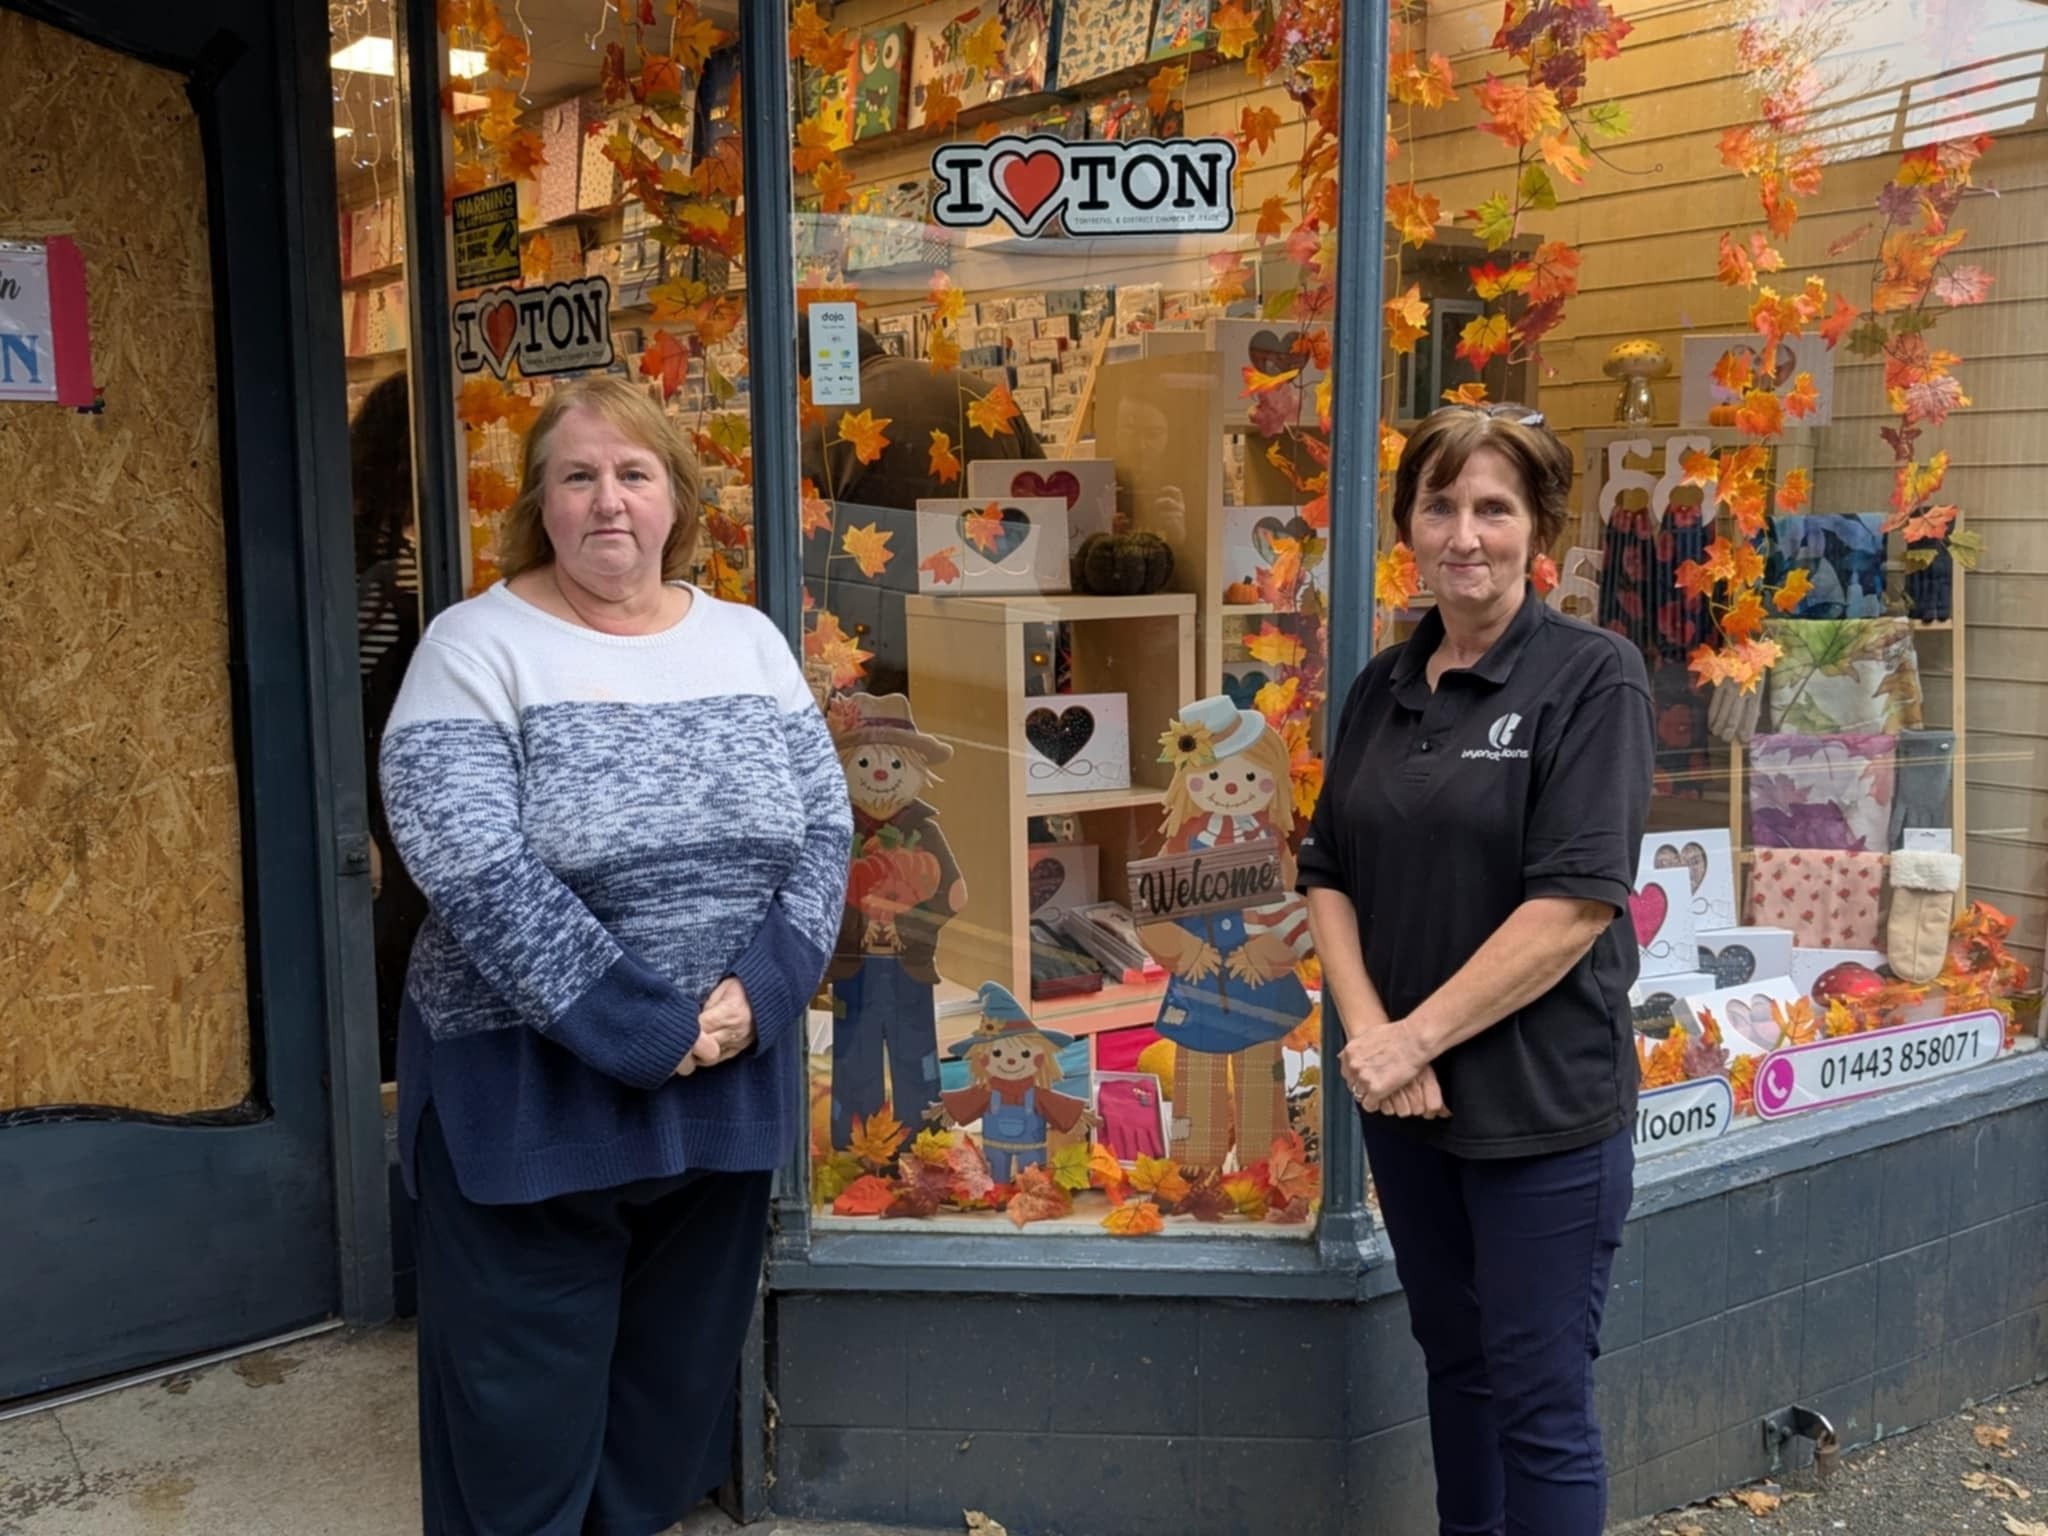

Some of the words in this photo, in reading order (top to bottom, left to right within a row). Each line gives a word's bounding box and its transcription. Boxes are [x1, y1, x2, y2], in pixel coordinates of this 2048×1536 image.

[455, 187, 513, 218] WARNING
[945, 158, 984, 212] I
[1071, 154, 1222, 210] TON
[458, 312, 477, 361] I
[520, 291, 602, 352] TON
[821, 312, 845, 323] dojo
[1139, 858, 1275, 914] Welcome
[1821, 1046, 1893, 1089] 01443
[1900, 1030, 1979, 1073] 858071
